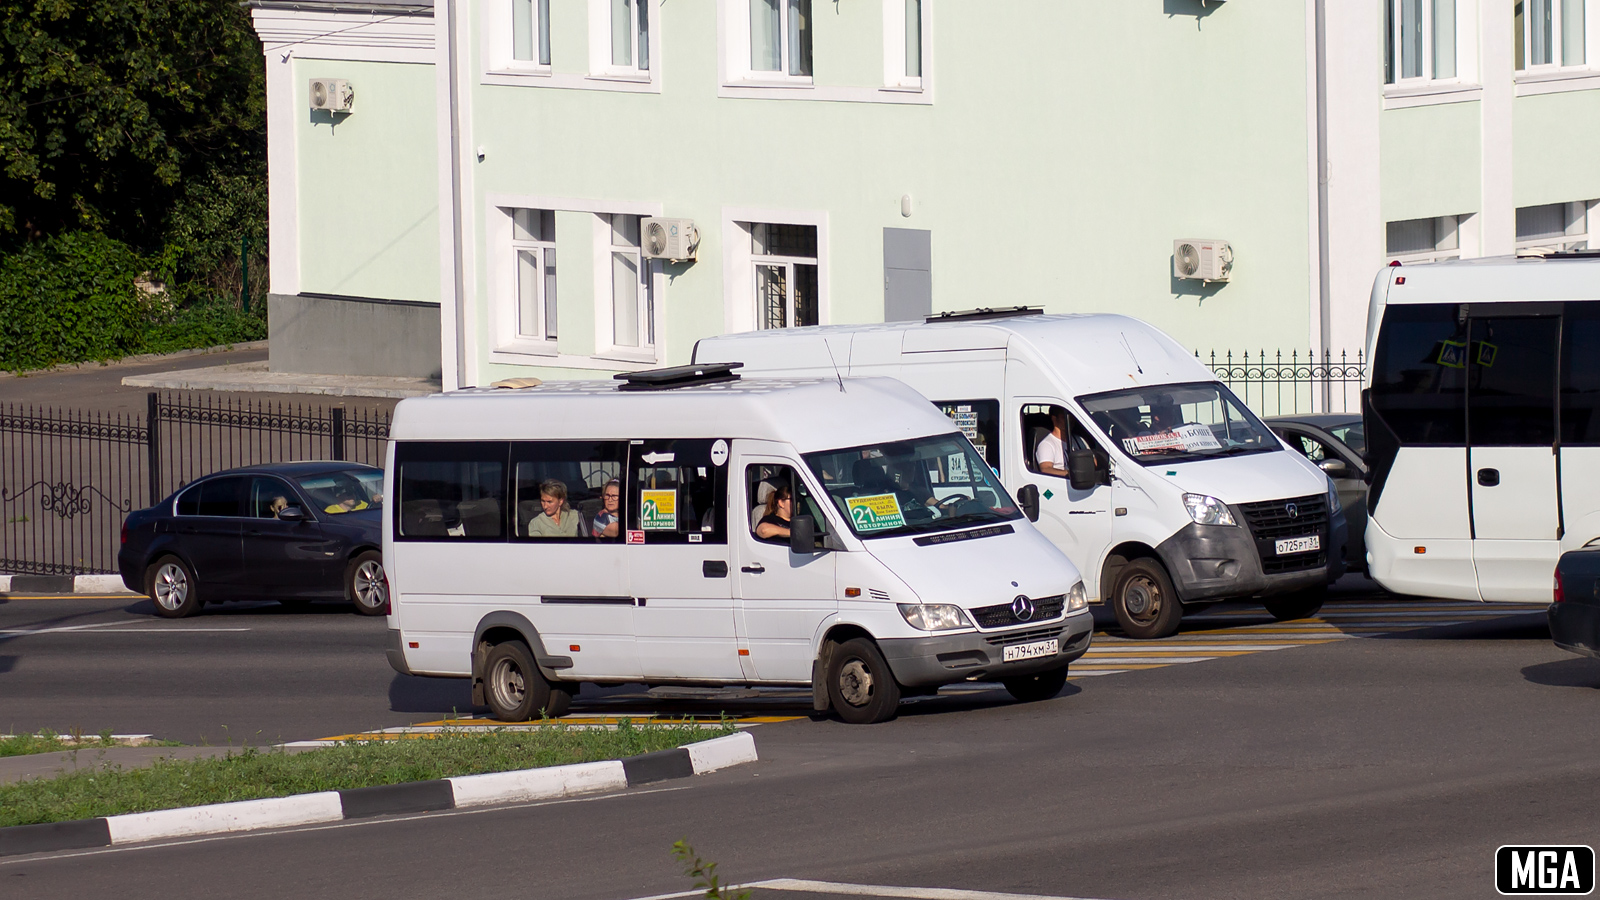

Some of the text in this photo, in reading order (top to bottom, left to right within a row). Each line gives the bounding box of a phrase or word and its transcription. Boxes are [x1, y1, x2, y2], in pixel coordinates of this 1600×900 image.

[643, 501, 657, 521] 21
[853, 506, 875, 524] 21
[875, 514, 901, 522] ЛИНИЯ
[858, 520, 903, 529] АВТОРЫНОК
[1309, 537, 1317, 546] 31
[1046, 641, 1055, 650] 31
